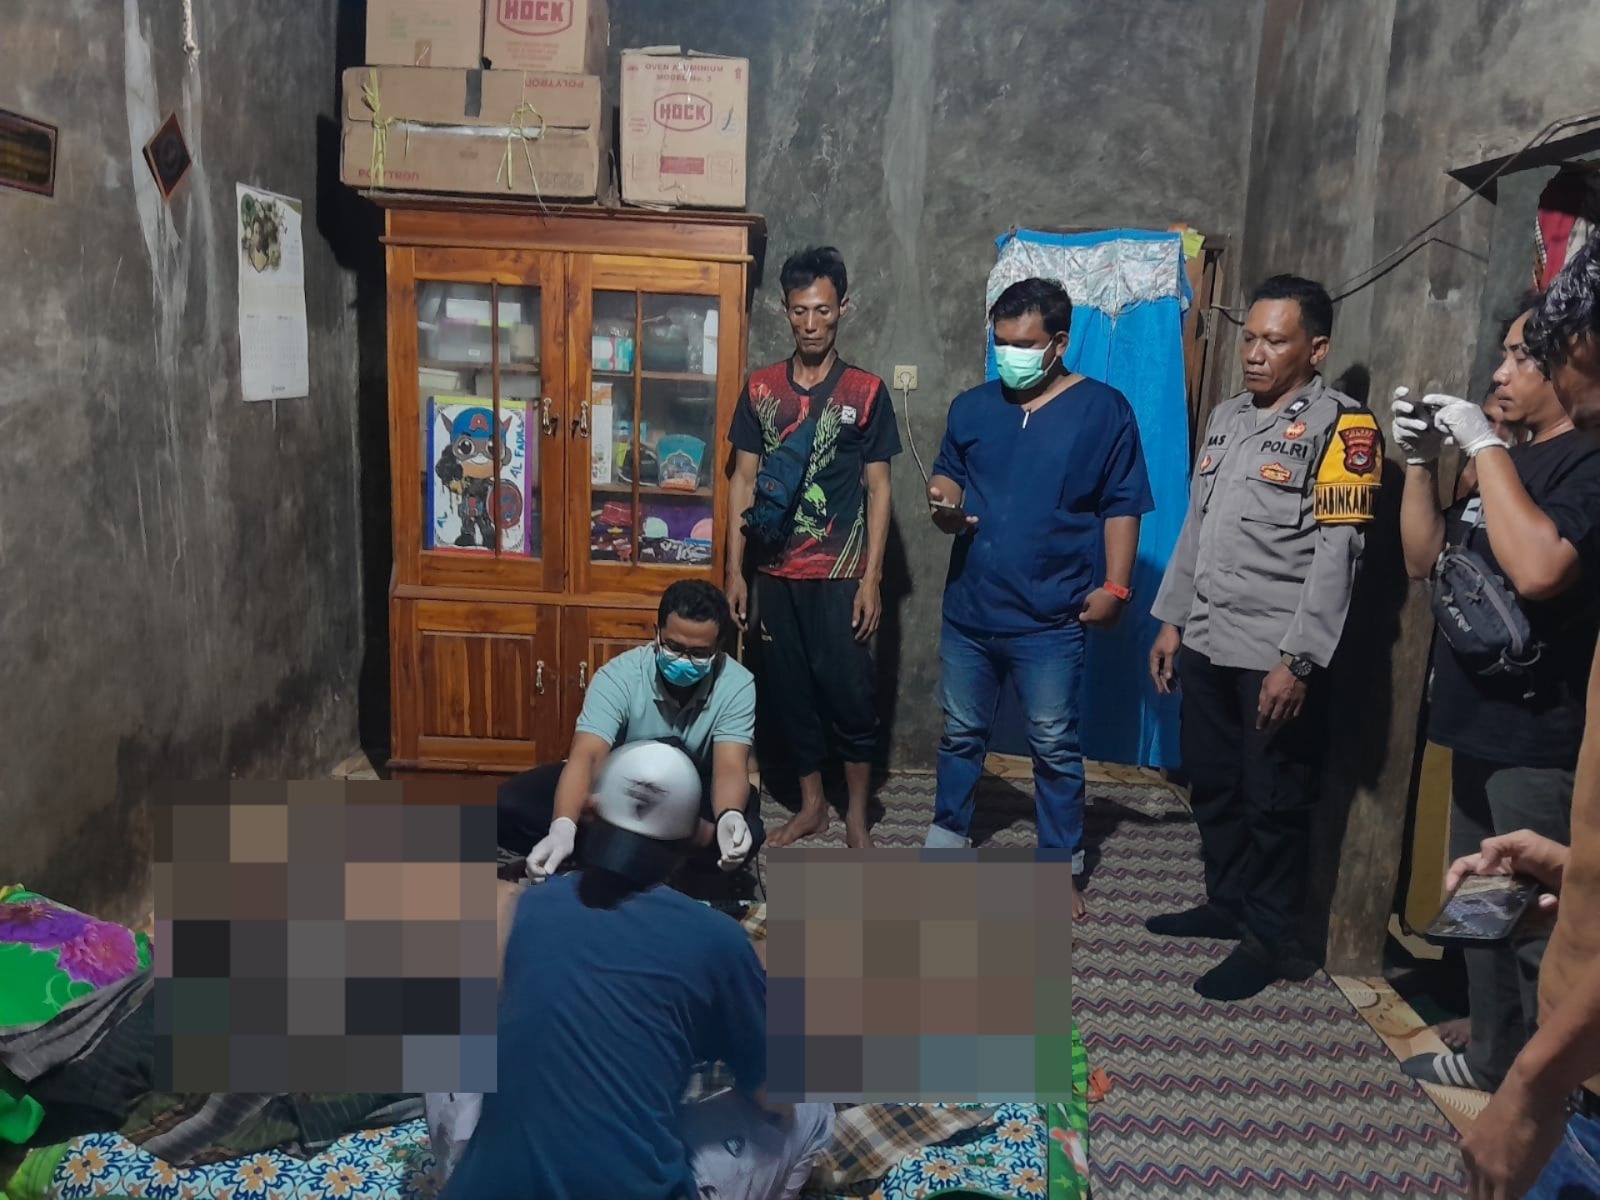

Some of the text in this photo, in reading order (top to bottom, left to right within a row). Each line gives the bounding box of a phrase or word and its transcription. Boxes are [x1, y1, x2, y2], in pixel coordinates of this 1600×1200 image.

[505, 0, 563, 21] HOCK
[645, 63, 669, 71] OVEN
[660, 104, 705, 120] HOCK
[1261, 440, 1308, 459] POLRI
